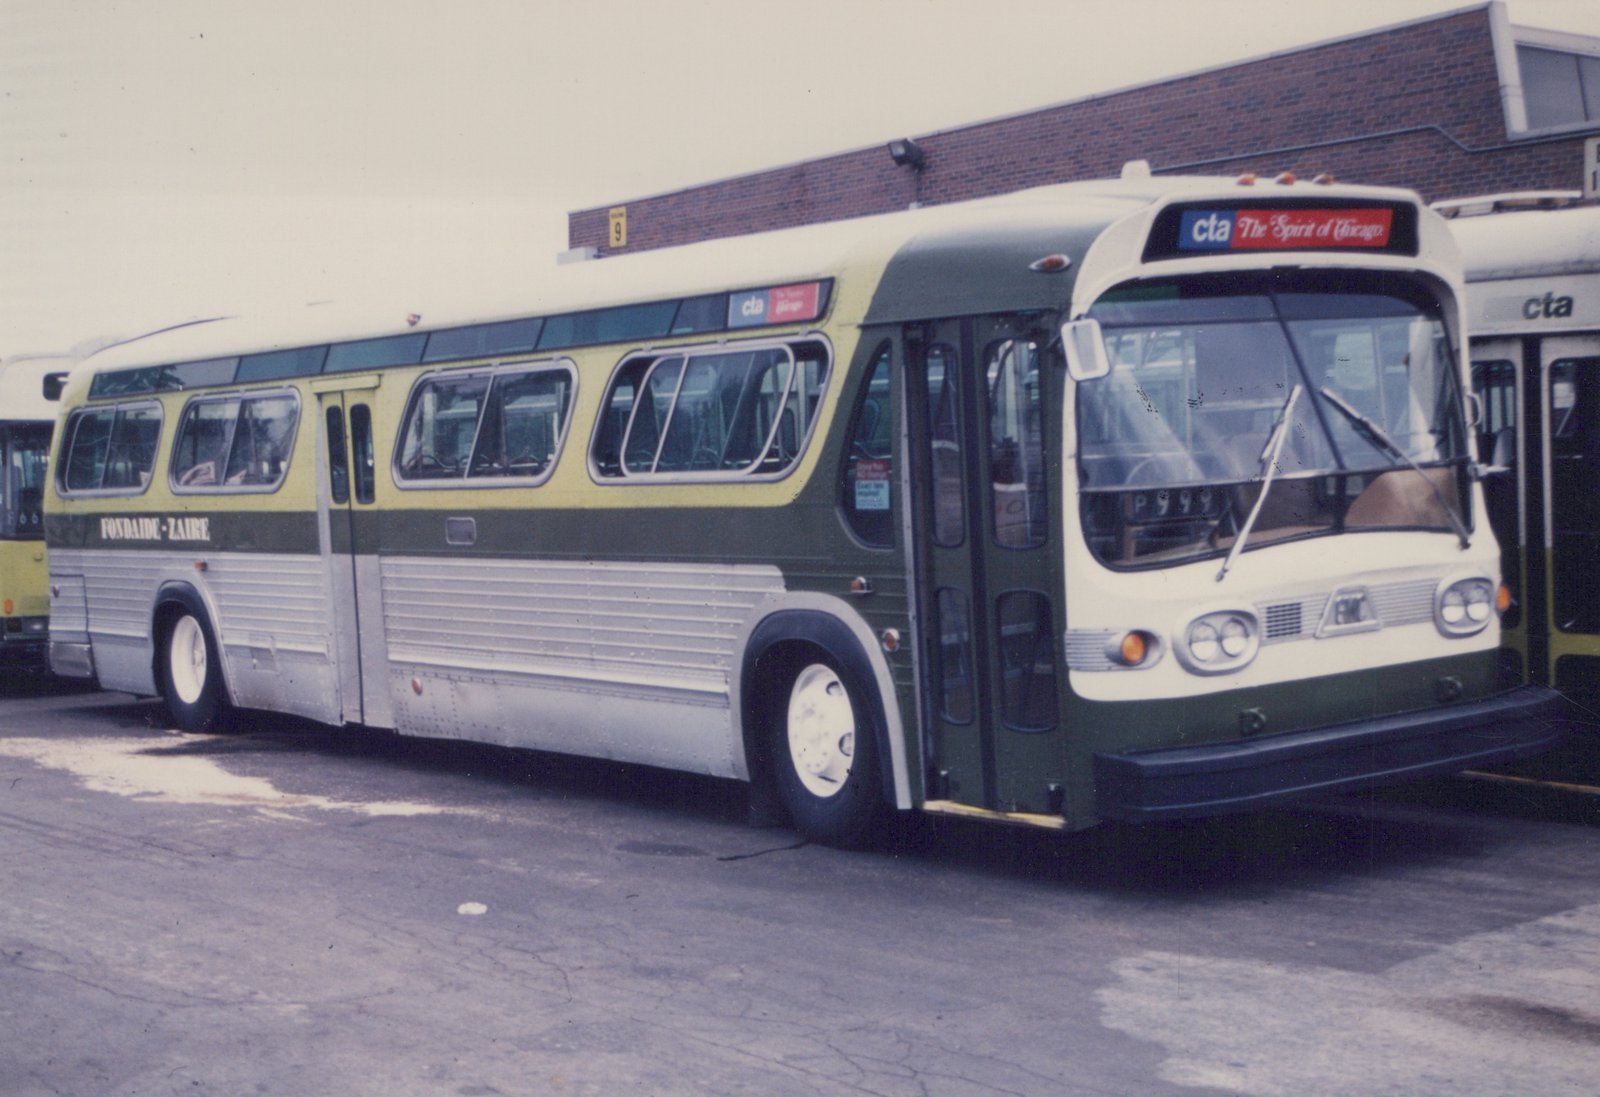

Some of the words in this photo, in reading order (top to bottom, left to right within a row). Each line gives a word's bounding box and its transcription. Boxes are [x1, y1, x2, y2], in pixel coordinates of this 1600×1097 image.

[614, 221, 622, 242] 9
[1192, 213, 1231, 243] cta
[1238, 216, 1267, 238] The
[1270, 214, 1312, 241] Spirit
[1316, 217, 1333, 237] of
[742, 295, 764, 317] cta
[1522, 291, 1574, 320] cta
